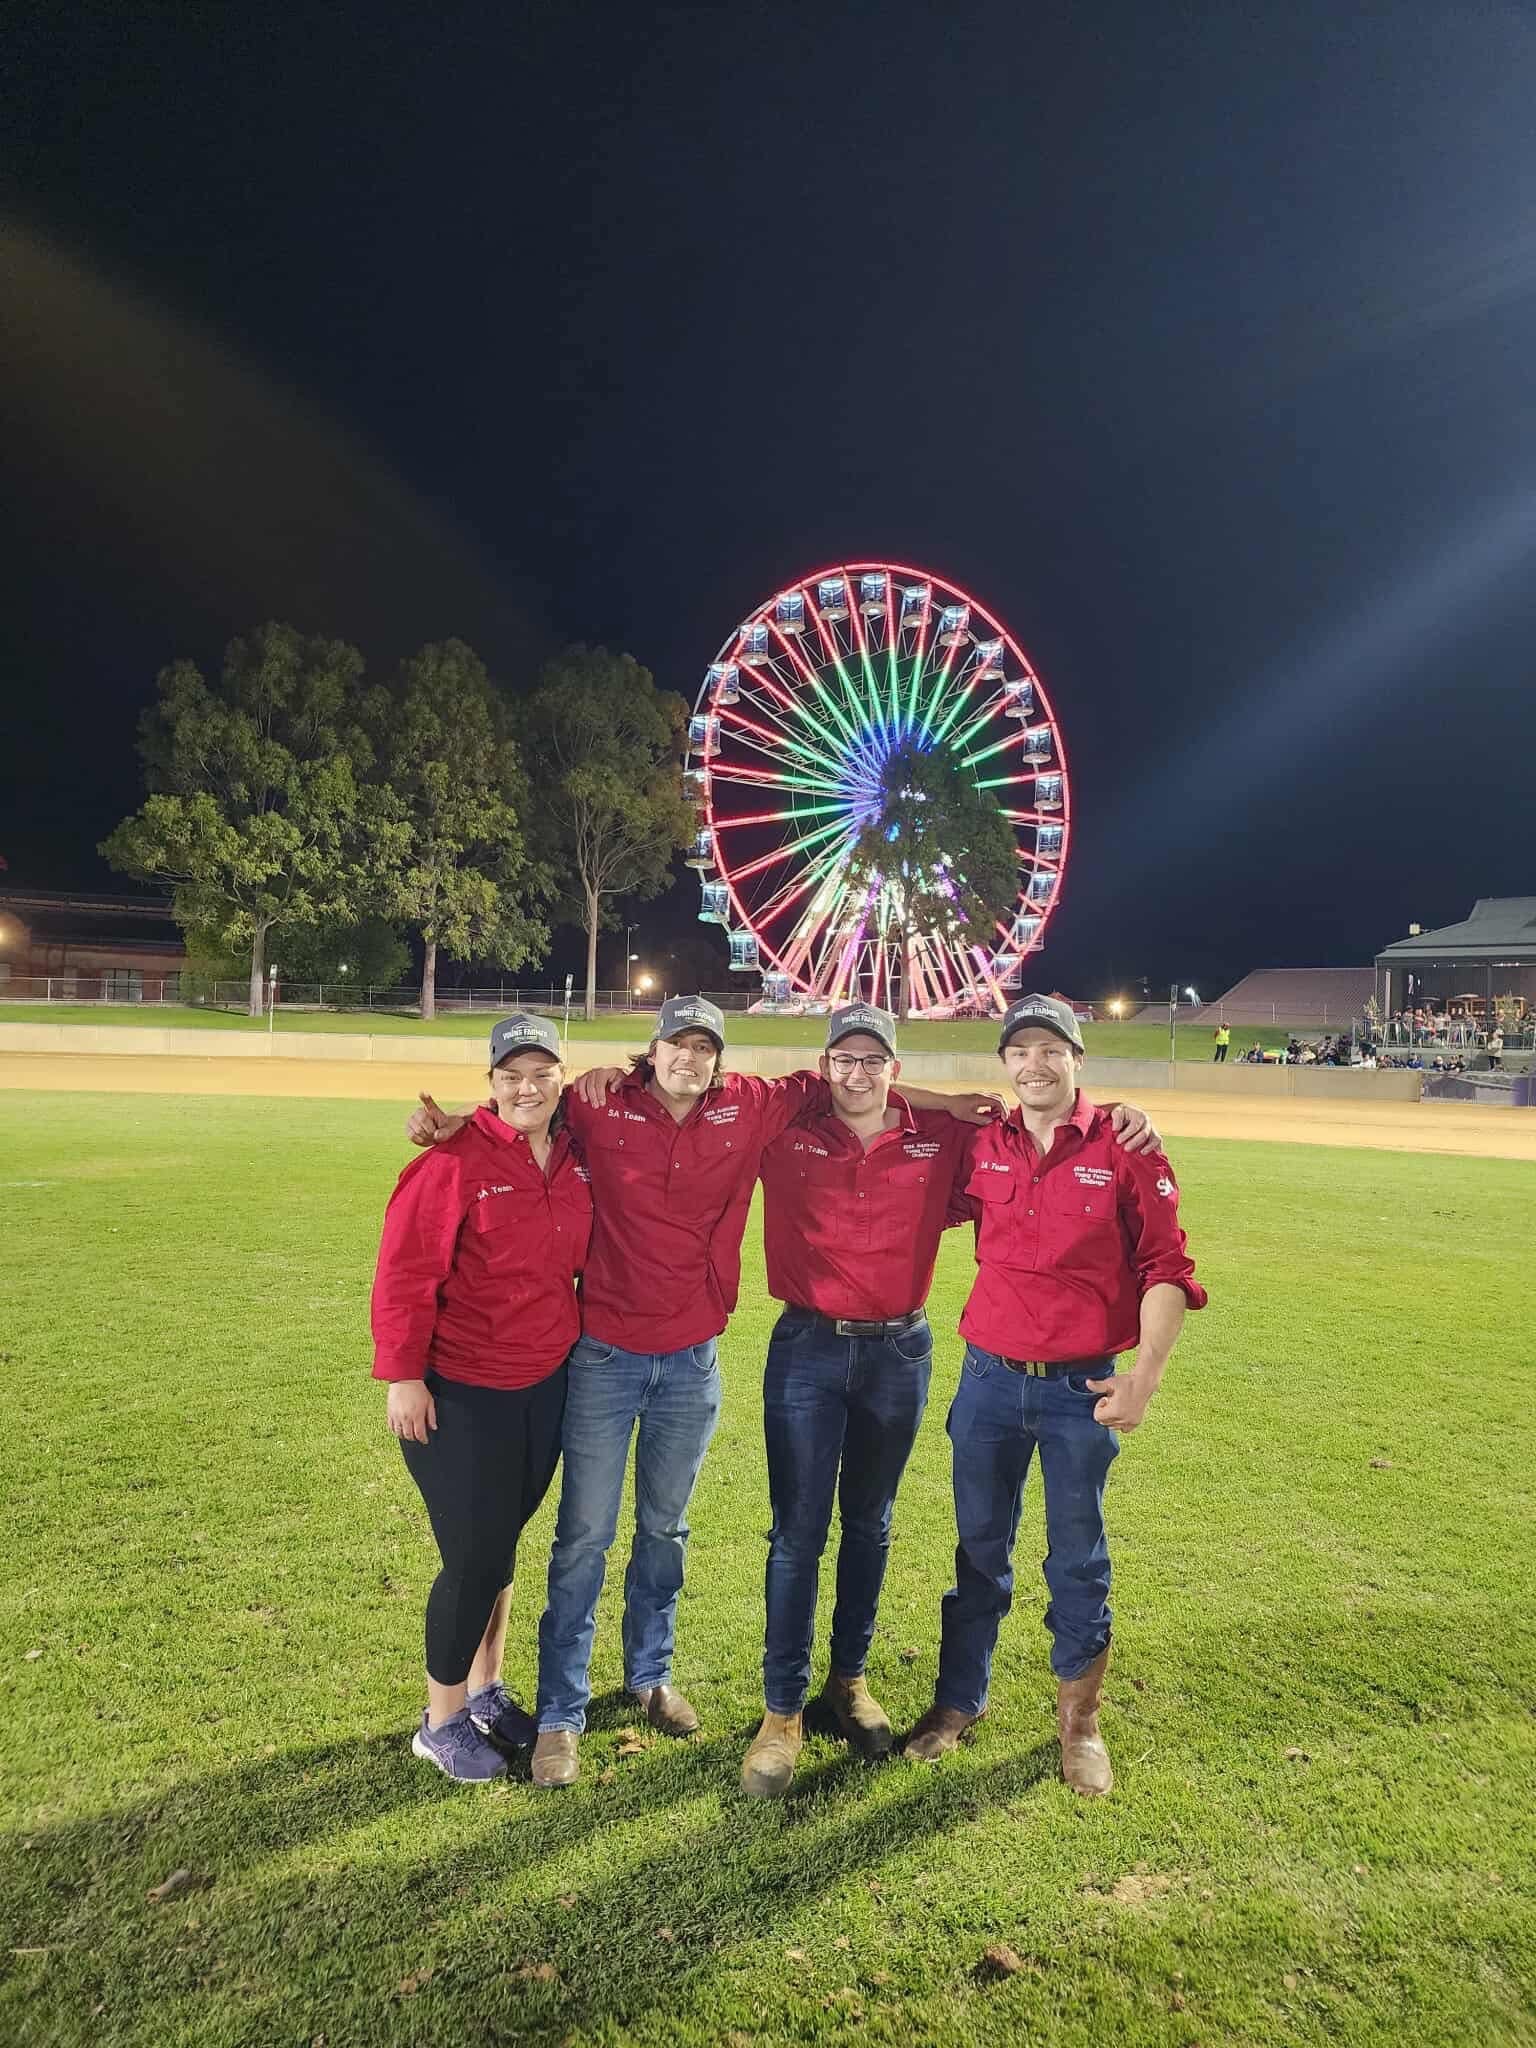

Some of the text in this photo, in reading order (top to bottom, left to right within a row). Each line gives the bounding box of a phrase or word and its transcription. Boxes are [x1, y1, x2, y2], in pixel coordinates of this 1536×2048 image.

[674, 1009, 695, 1018] YOUNG
[502, 1028, 523, 1041] YOUNG
[607, 1108, 647, 1123] SA Team
[793, 1142, 829, 1158] SA Team
[991, 1162, 1010, 1173] Team
[476, 1185, 514, 1201] SA Team
